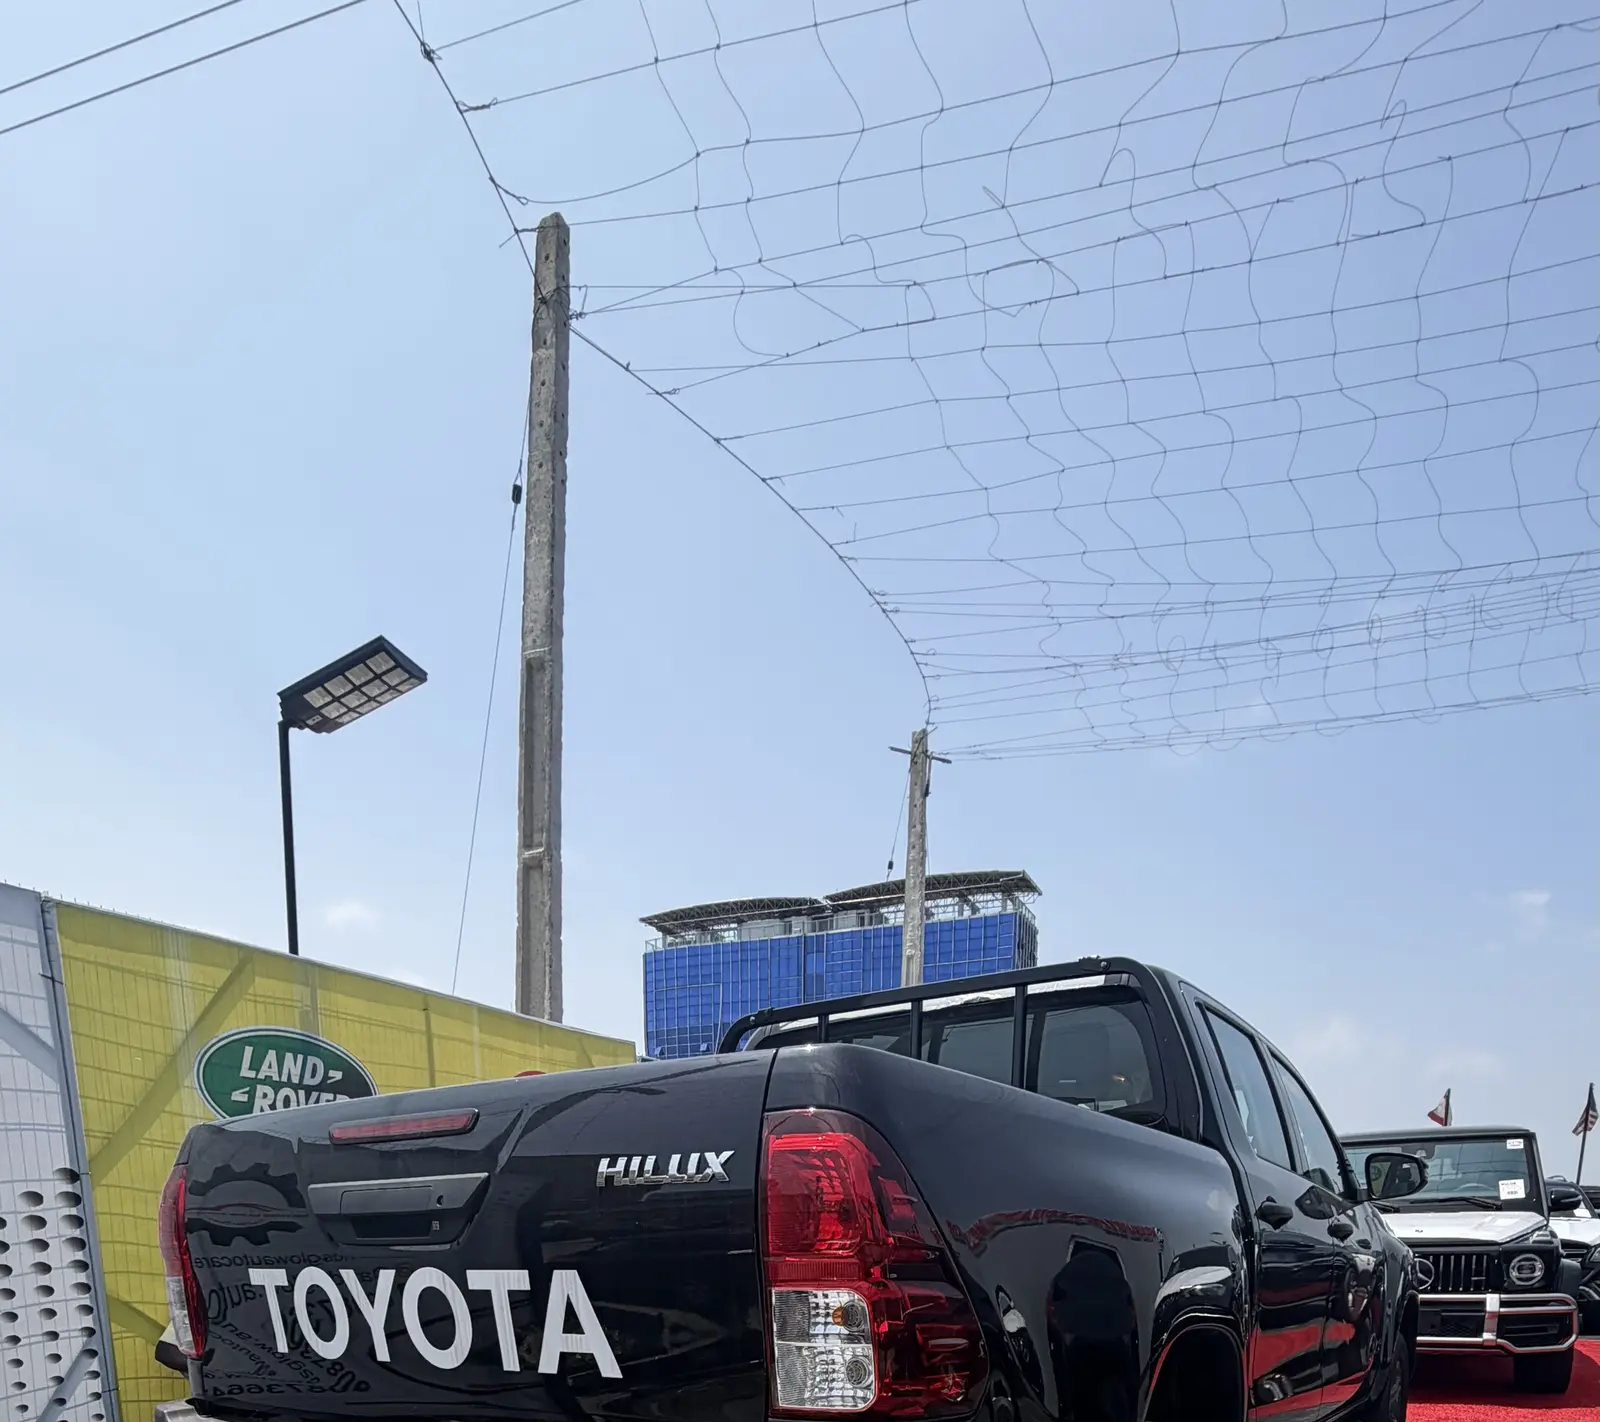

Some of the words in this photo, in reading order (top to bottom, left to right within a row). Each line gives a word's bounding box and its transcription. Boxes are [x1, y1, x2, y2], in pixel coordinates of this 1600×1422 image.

[240, 1046, 324, 1086] LAND
[253, 1084, 350, 1114] ROV
[596, 1150, 735, 1187] HILUX
[249, 1266, 622, 1379] TOYOTA
